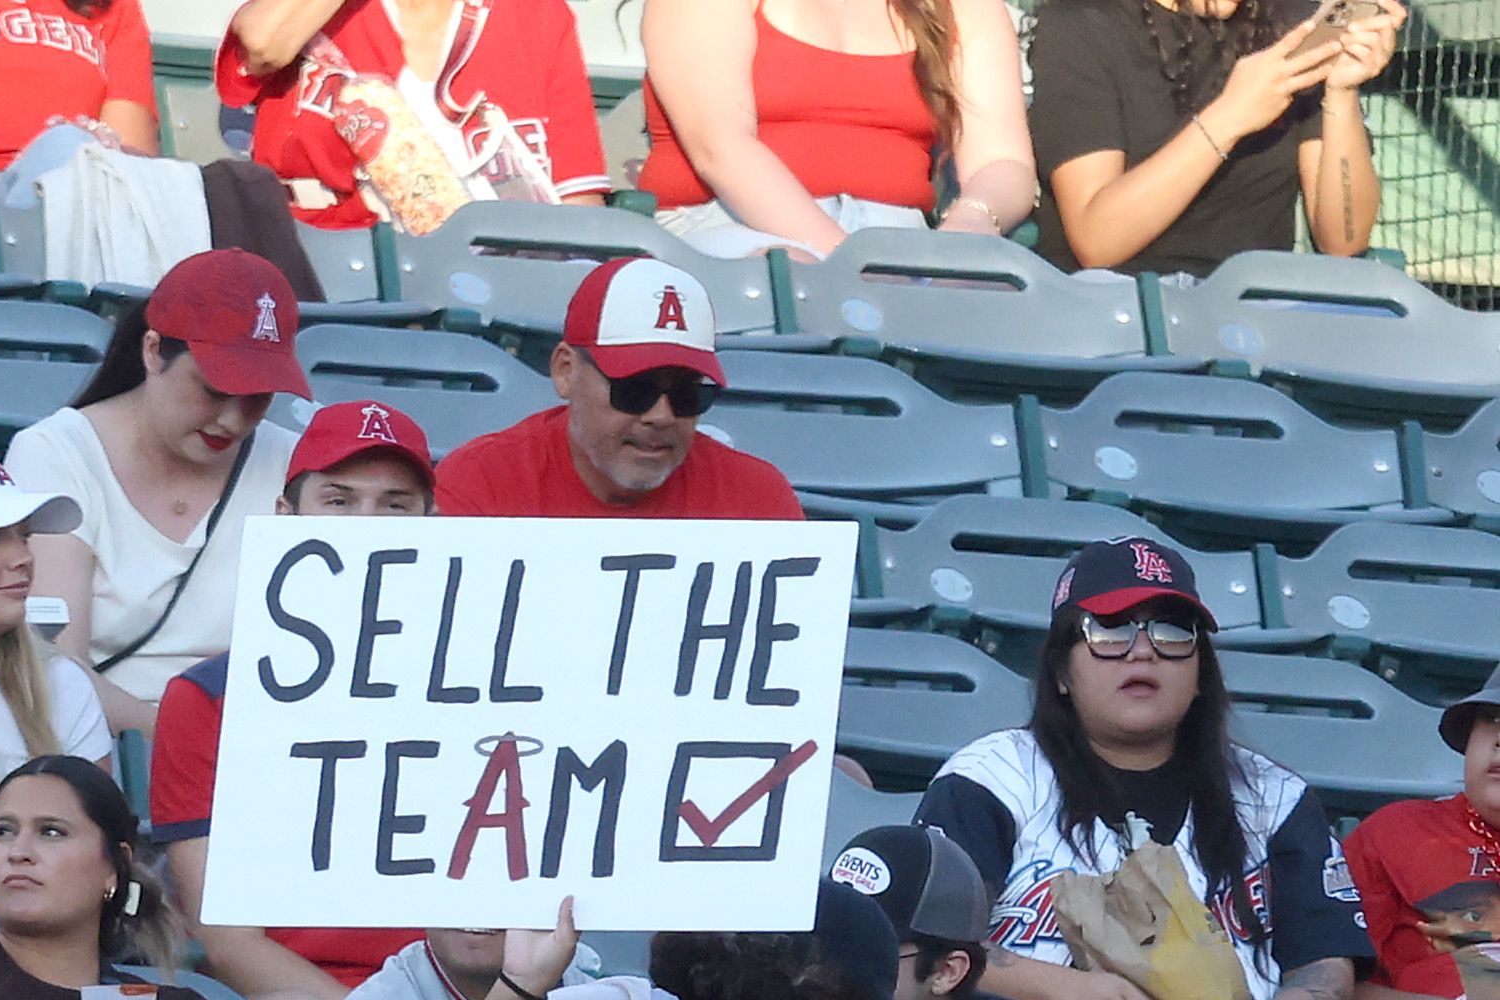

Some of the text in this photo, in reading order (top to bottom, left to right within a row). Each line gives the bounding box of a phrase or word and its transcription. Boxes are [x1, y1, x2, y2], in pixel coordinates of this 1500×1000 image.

[253, 292, 280, 342] A
[653, 285, 688, 331] A
[357, 403, 398, 443] A
[1130, 543, 1174, 583] LA
[257, 539, 822, 707] SELL THE
[289, 731, 628, 881] TEAM
[839, 854, 882, 881] EVENTS
